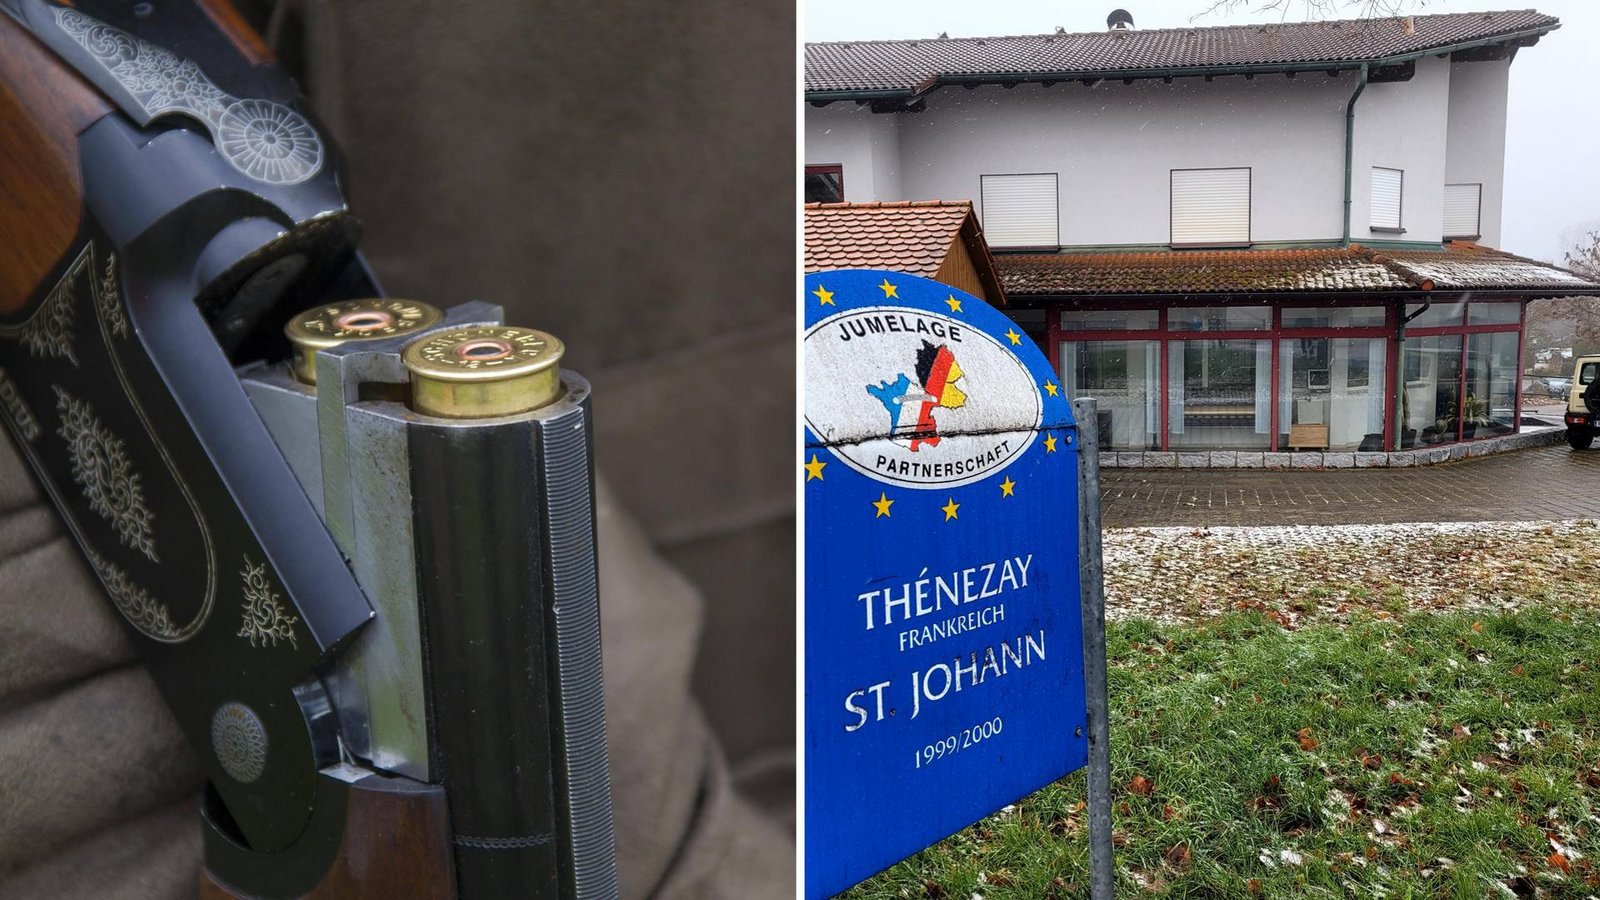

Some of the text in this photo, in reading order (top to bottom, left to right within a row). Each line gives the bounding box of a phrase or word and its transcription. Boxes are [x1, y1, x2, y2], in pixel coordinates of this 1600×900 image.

[839, 314, 963, 343] JUMELAGE
[876, 440, 1010, 478] PARTNERSCHAFT
[857, 553, 1033, 631] THÉNEZAY
[899, 603, 1006, 652] FRANKREICH
[910, 629, 1046, 720] JOHANN
[914, 716, 1003, 769] 1999/2000
